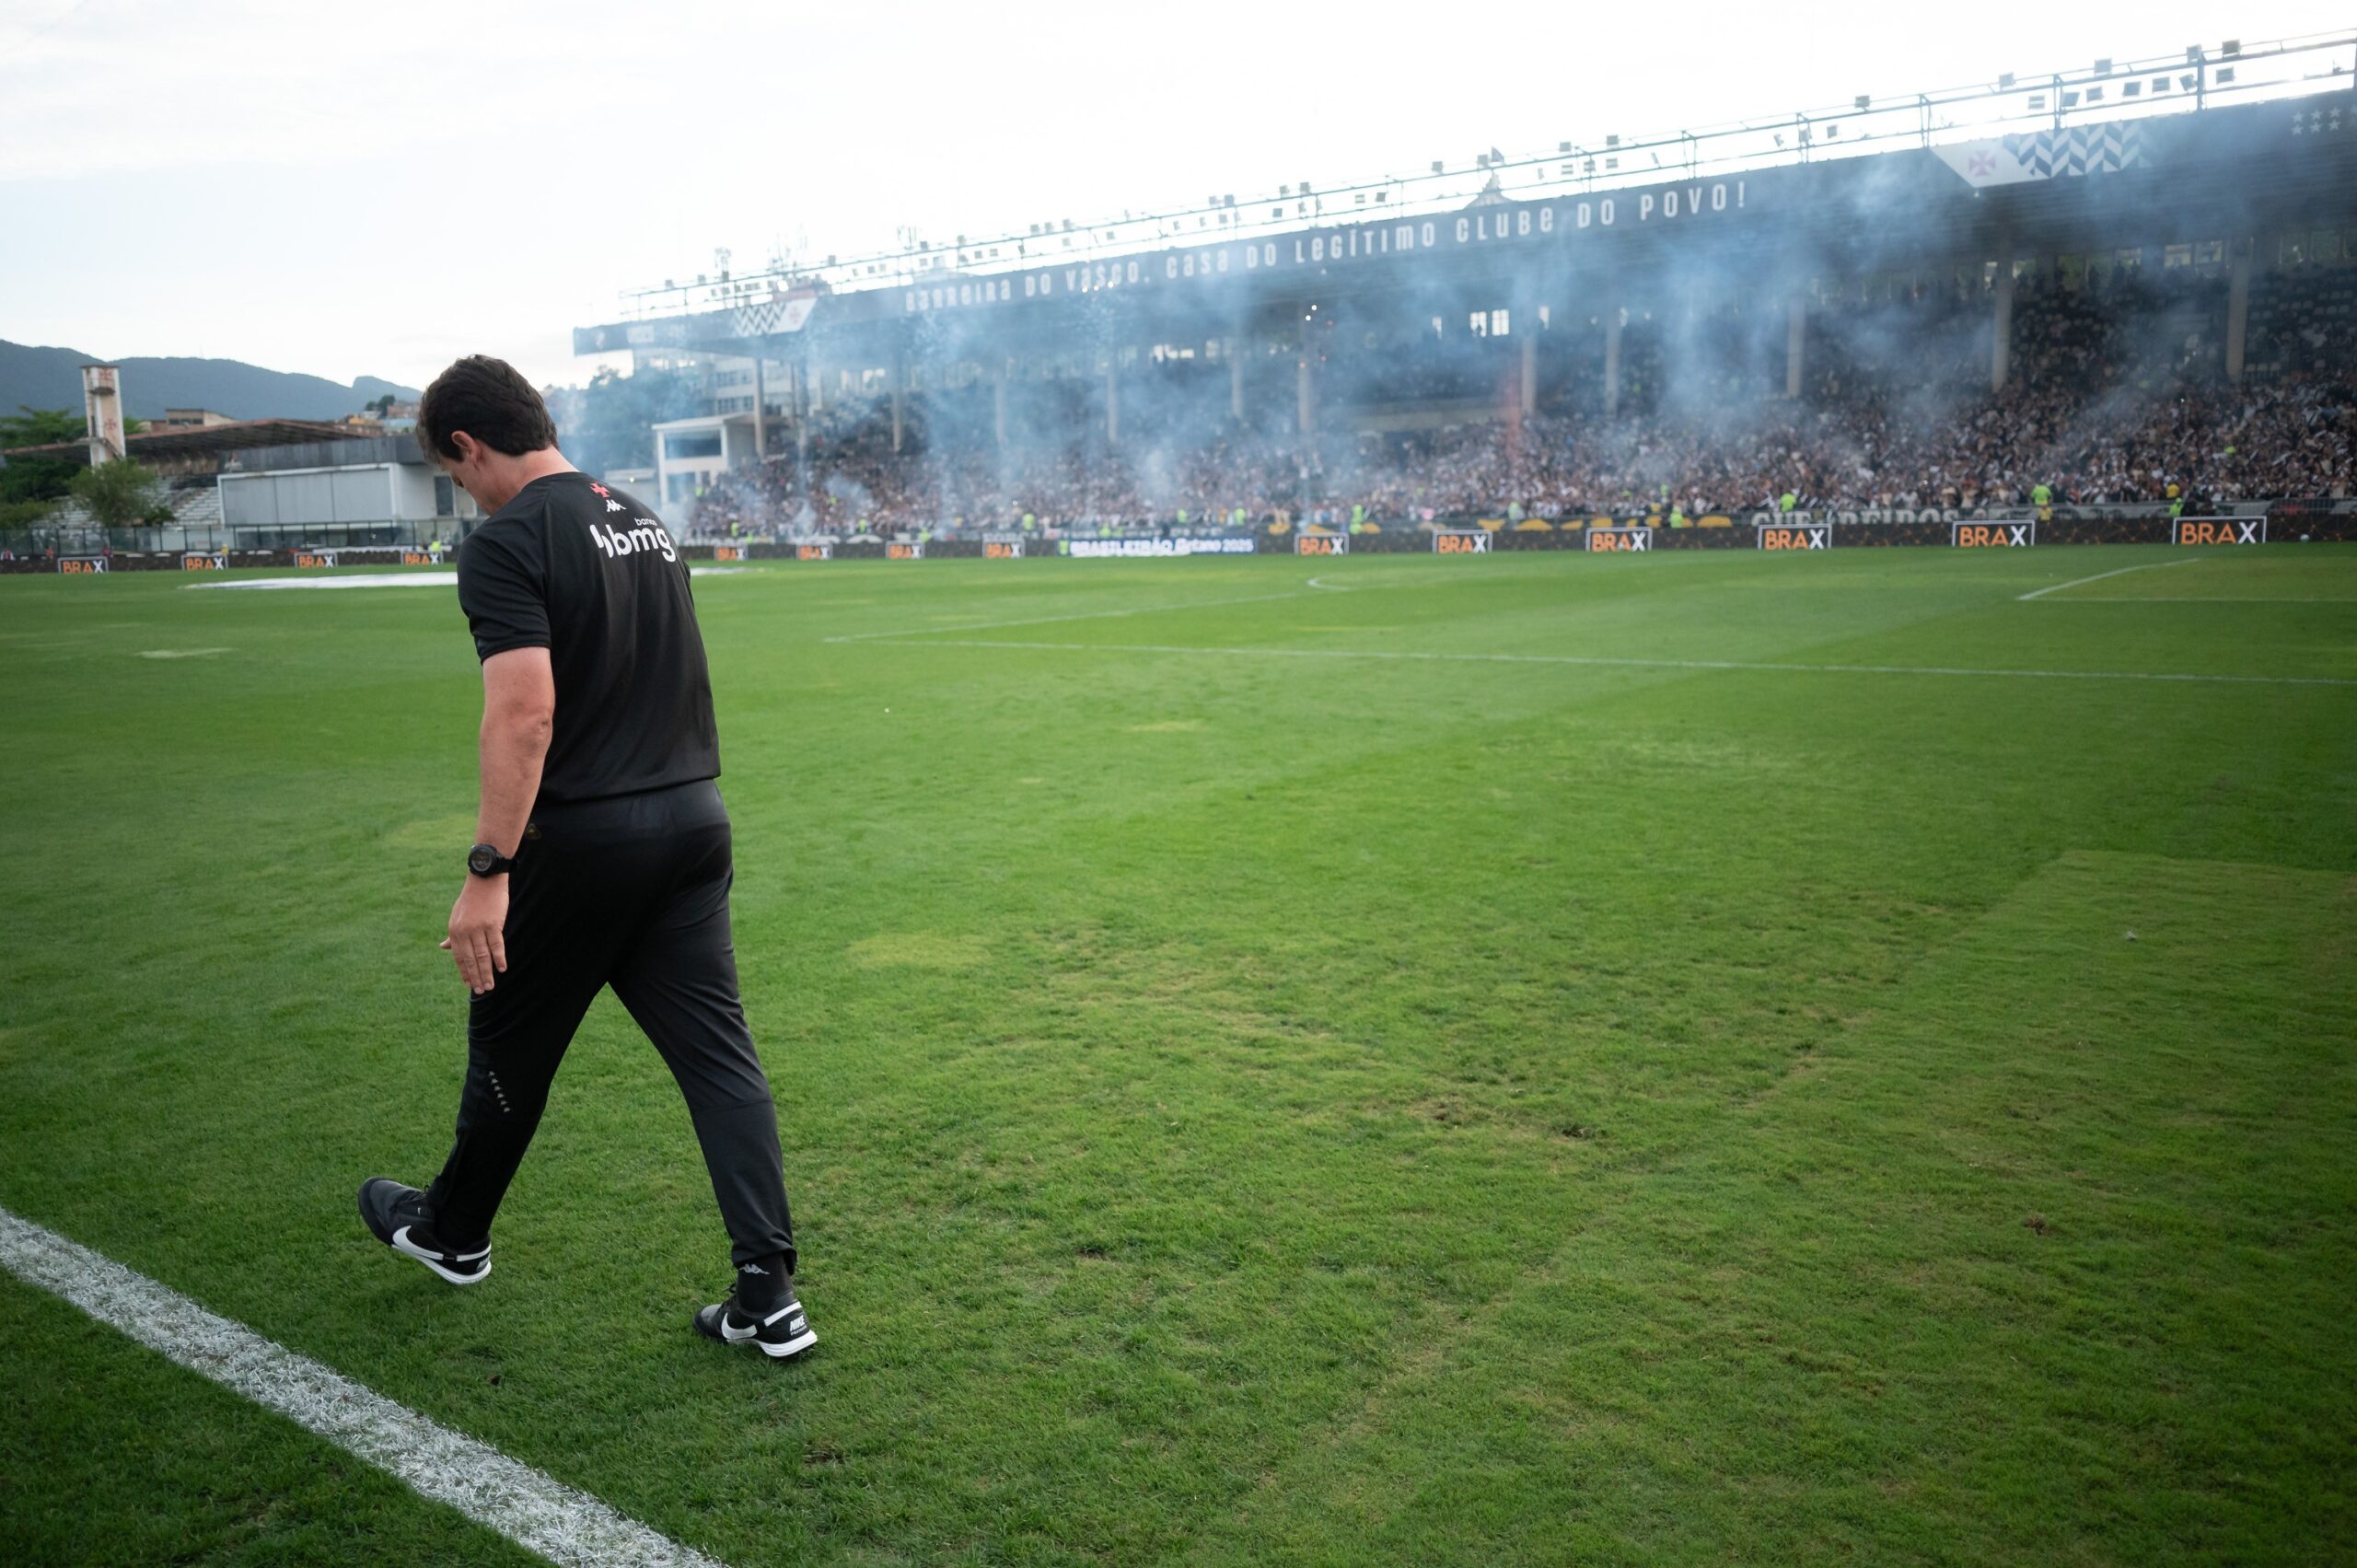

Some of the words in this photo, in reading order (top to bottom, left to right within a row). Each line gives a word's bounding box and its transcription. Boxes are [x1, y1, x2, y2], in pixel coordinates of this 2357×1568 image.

[1576, 198, 1616, 229] DO
[1639, 180, 1746, 222] POVO!
[1591, 531, 1646, 552] BRAX
[1764, 528, 1824, 550] BRAX
[1959, 525, 2027, 547] BRAX
[2180, 521, 2258, 544] BRAX
[1300, 538, 1345, 555] BRAX
[1438, 535, 1487, 553] BRAX
[63, 560, 104, 574] BRAX
[186, 556, 224, 571] BRAX
[298, 554, 334, 567] BRAX
[404, 552, 439, 565] BRAX
